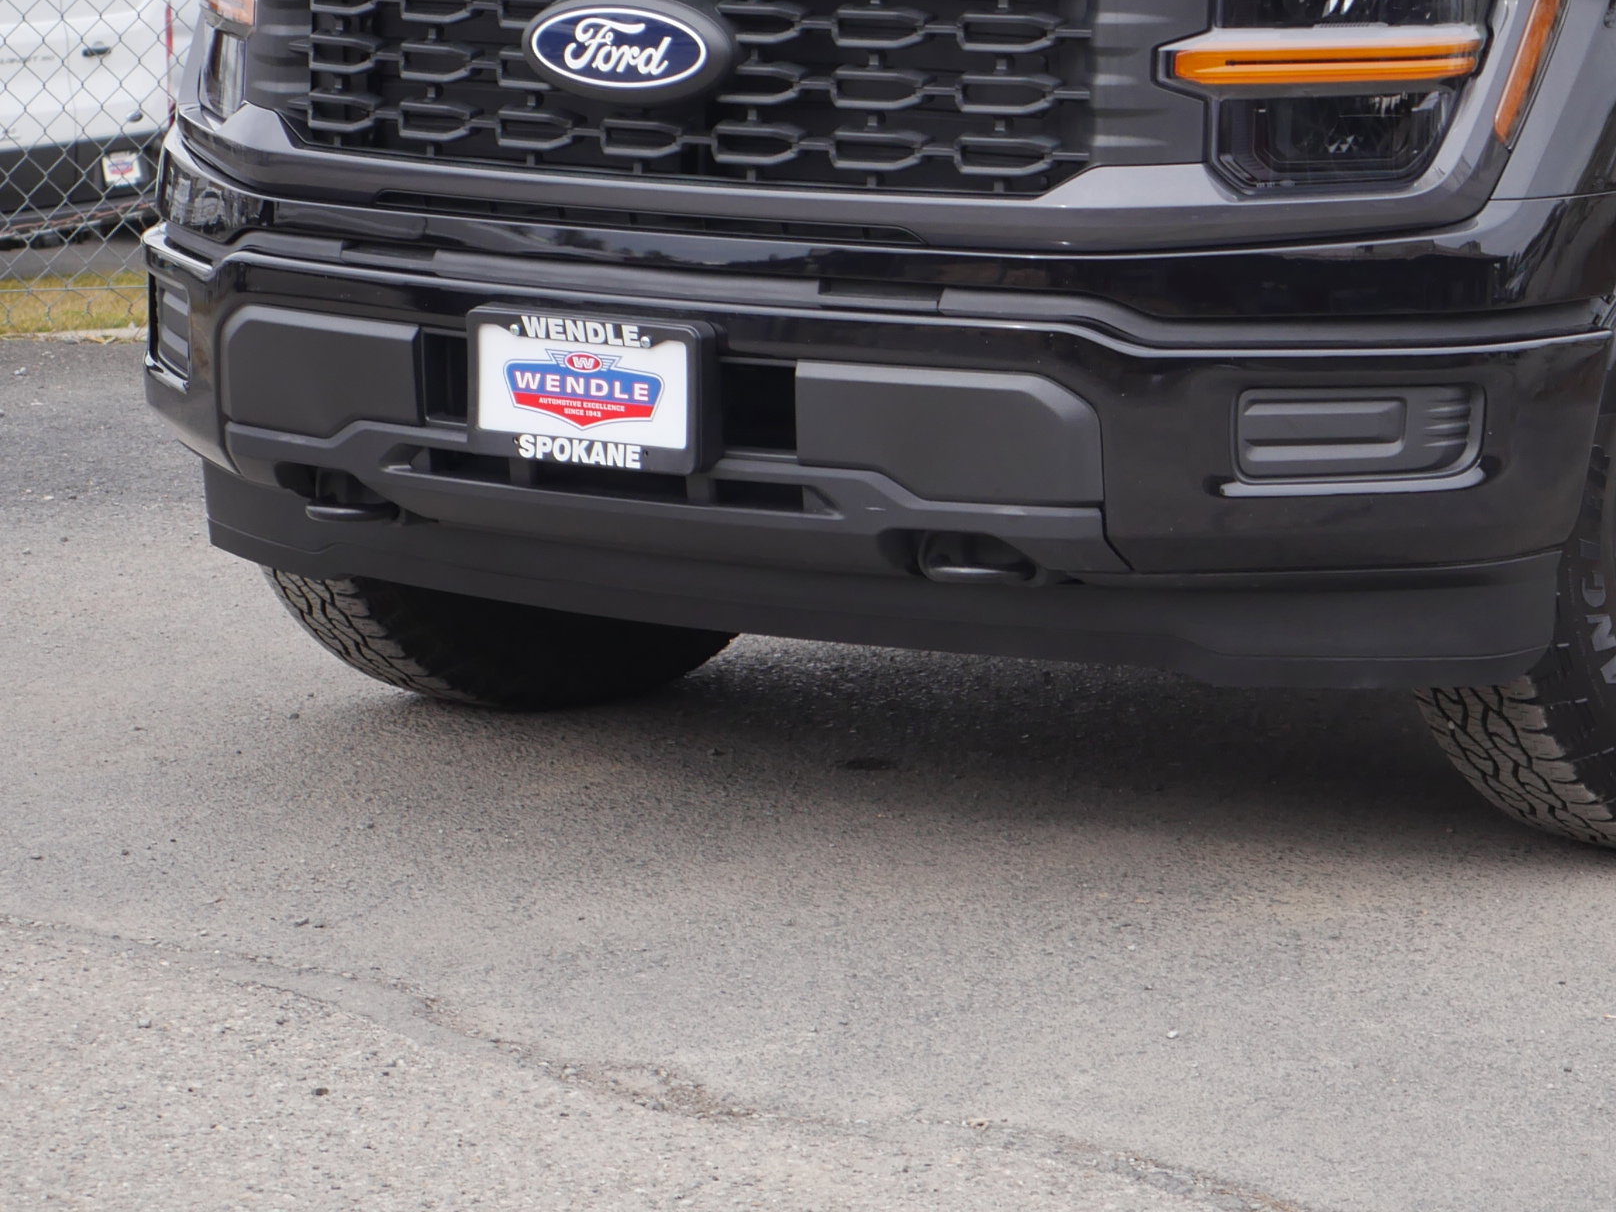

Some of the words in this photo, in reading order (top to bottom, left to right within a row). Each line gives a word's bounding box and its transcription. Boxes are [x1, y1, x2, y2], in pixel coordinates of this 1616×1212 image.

[563, 17, 672, 76] Ford
[520, 315, 642, 347] WENDLE
[572, 356, 594, 369] W
[514, 370, 649, 402] WENDLE
[538, 396, 582, 408] AUTOMOTIVE
[582, 401, 625, 412] EXCELLENCE
[563, 407, 585, 416] SINCE
[518, 433, 642, 469] SPOKANE
